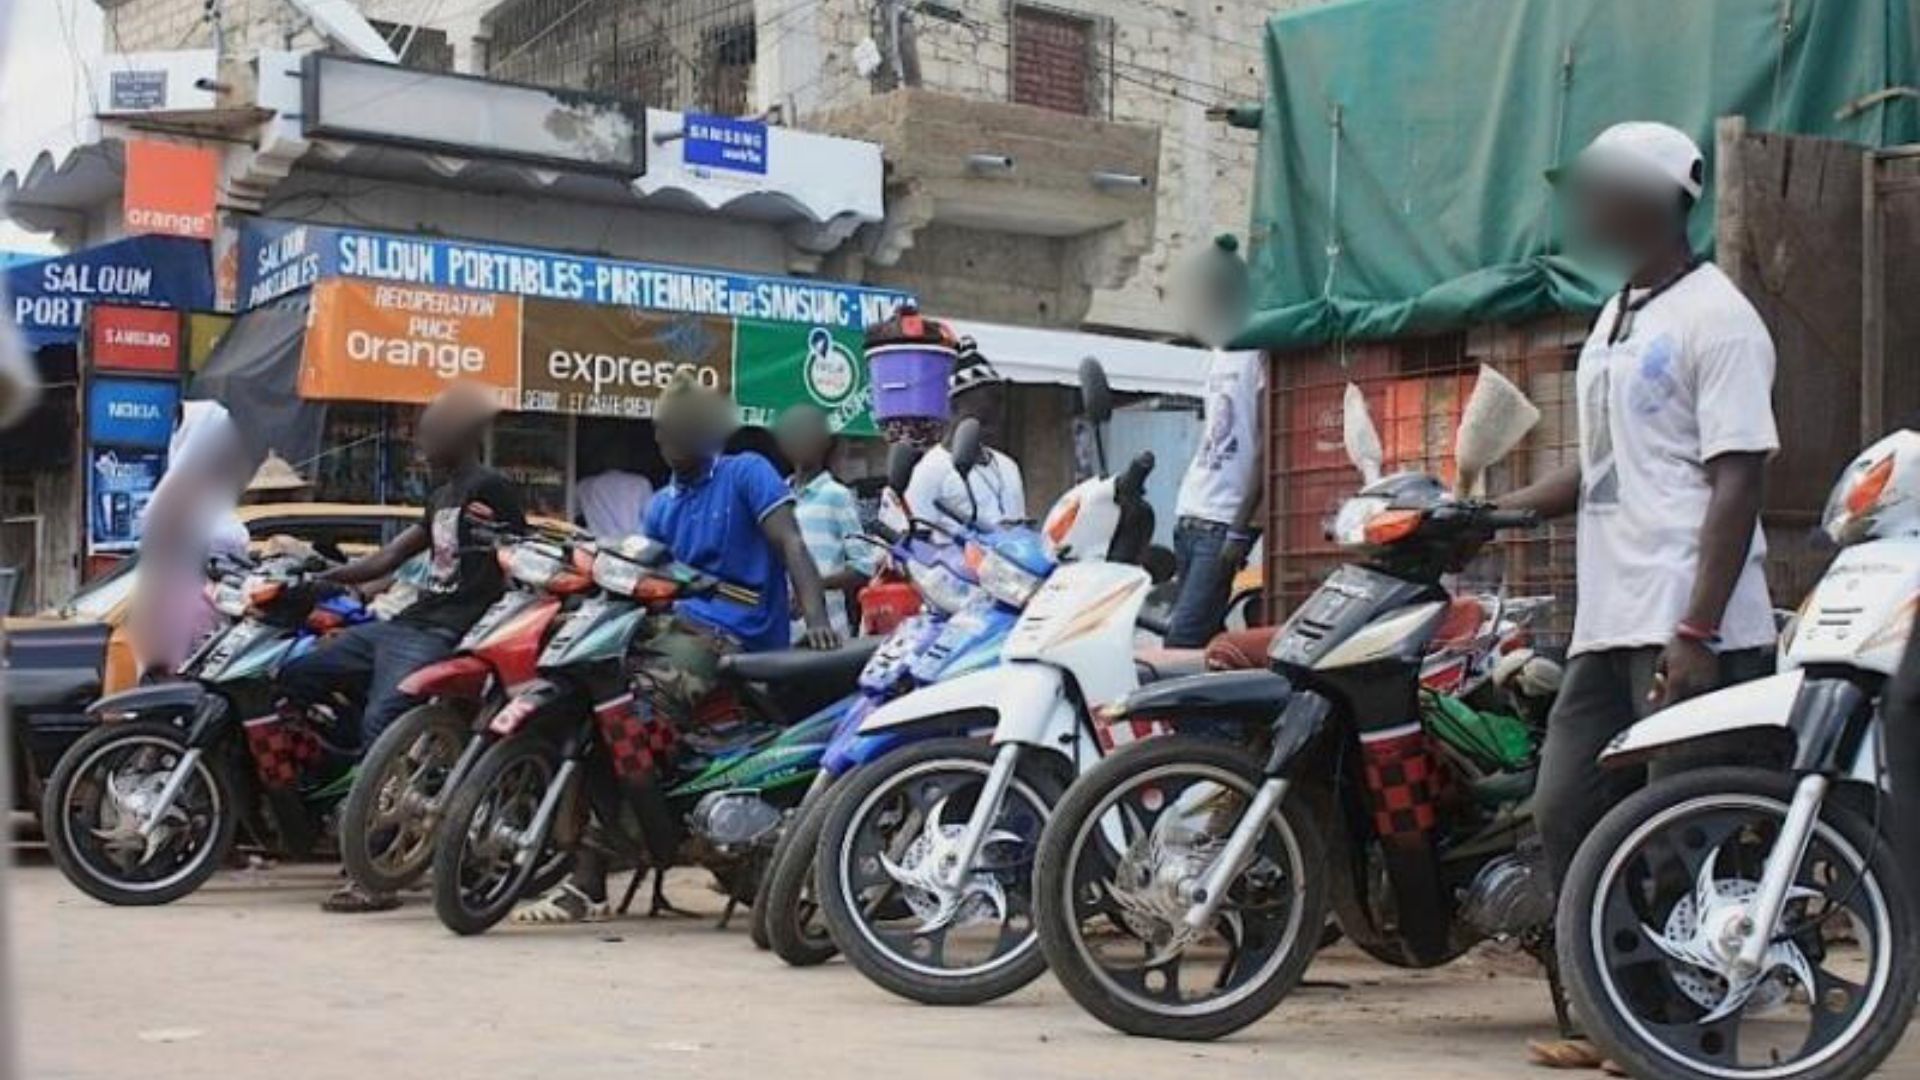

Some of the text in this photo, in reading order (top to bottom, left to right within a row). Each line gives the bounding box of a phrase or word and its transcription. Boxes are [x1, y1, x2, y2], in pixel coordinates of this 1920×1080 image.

[690, 125, 762, 148] SAMSUNG
[128, 209, 206, 234] orange
[339, 234, 436, 283] SALOUM
[43, 262, 152, 295] SALOUM
[105, 328, 172, 348] SAMSUNG
[108, 402, 160, 419] NOKIA
